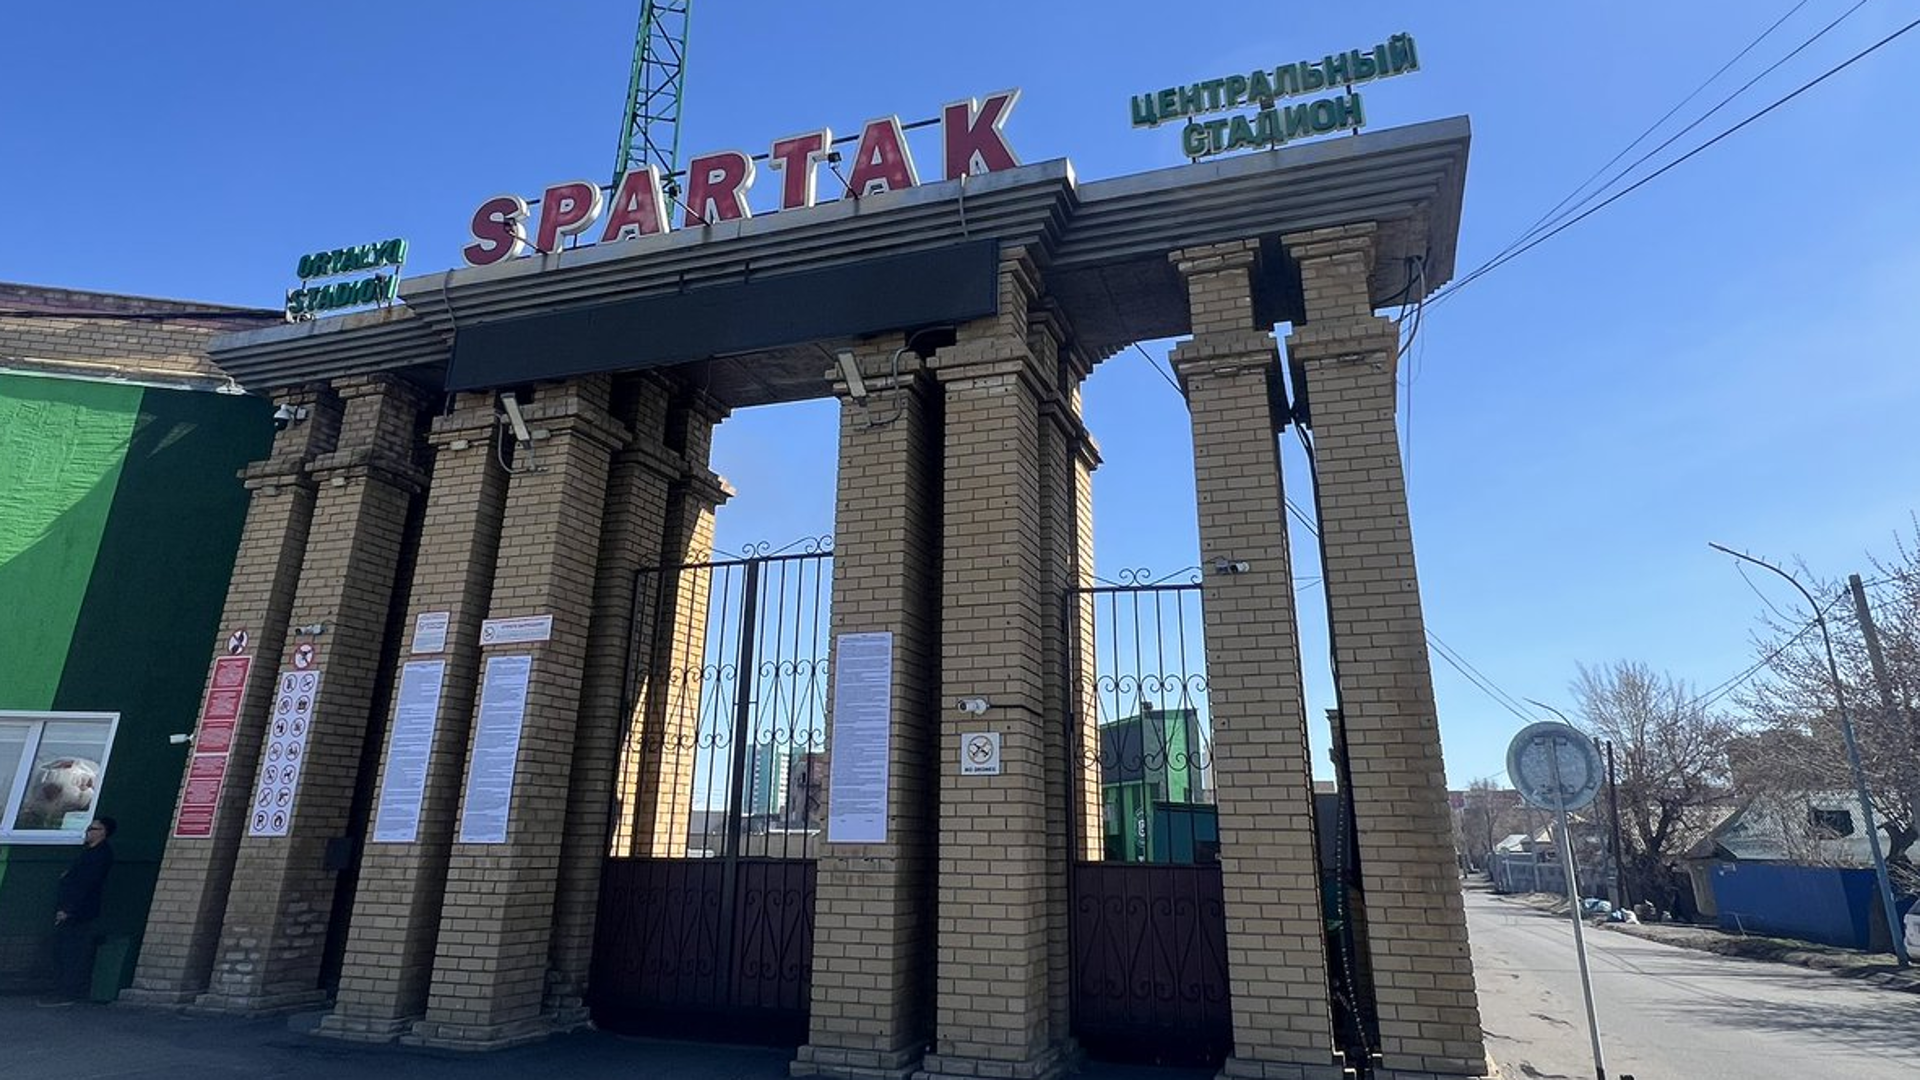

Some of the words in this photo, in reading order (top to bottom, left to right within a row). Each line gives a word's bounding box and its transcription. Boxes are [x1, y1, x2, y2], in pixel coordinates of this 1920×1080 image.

[1131, 31, 1420, 128] ЦЕНТРАЛЬНЫЙ
[1182, 92, 1366, 158] СТАДИОН
[462, 87, 1022, 267] SPARTAK
